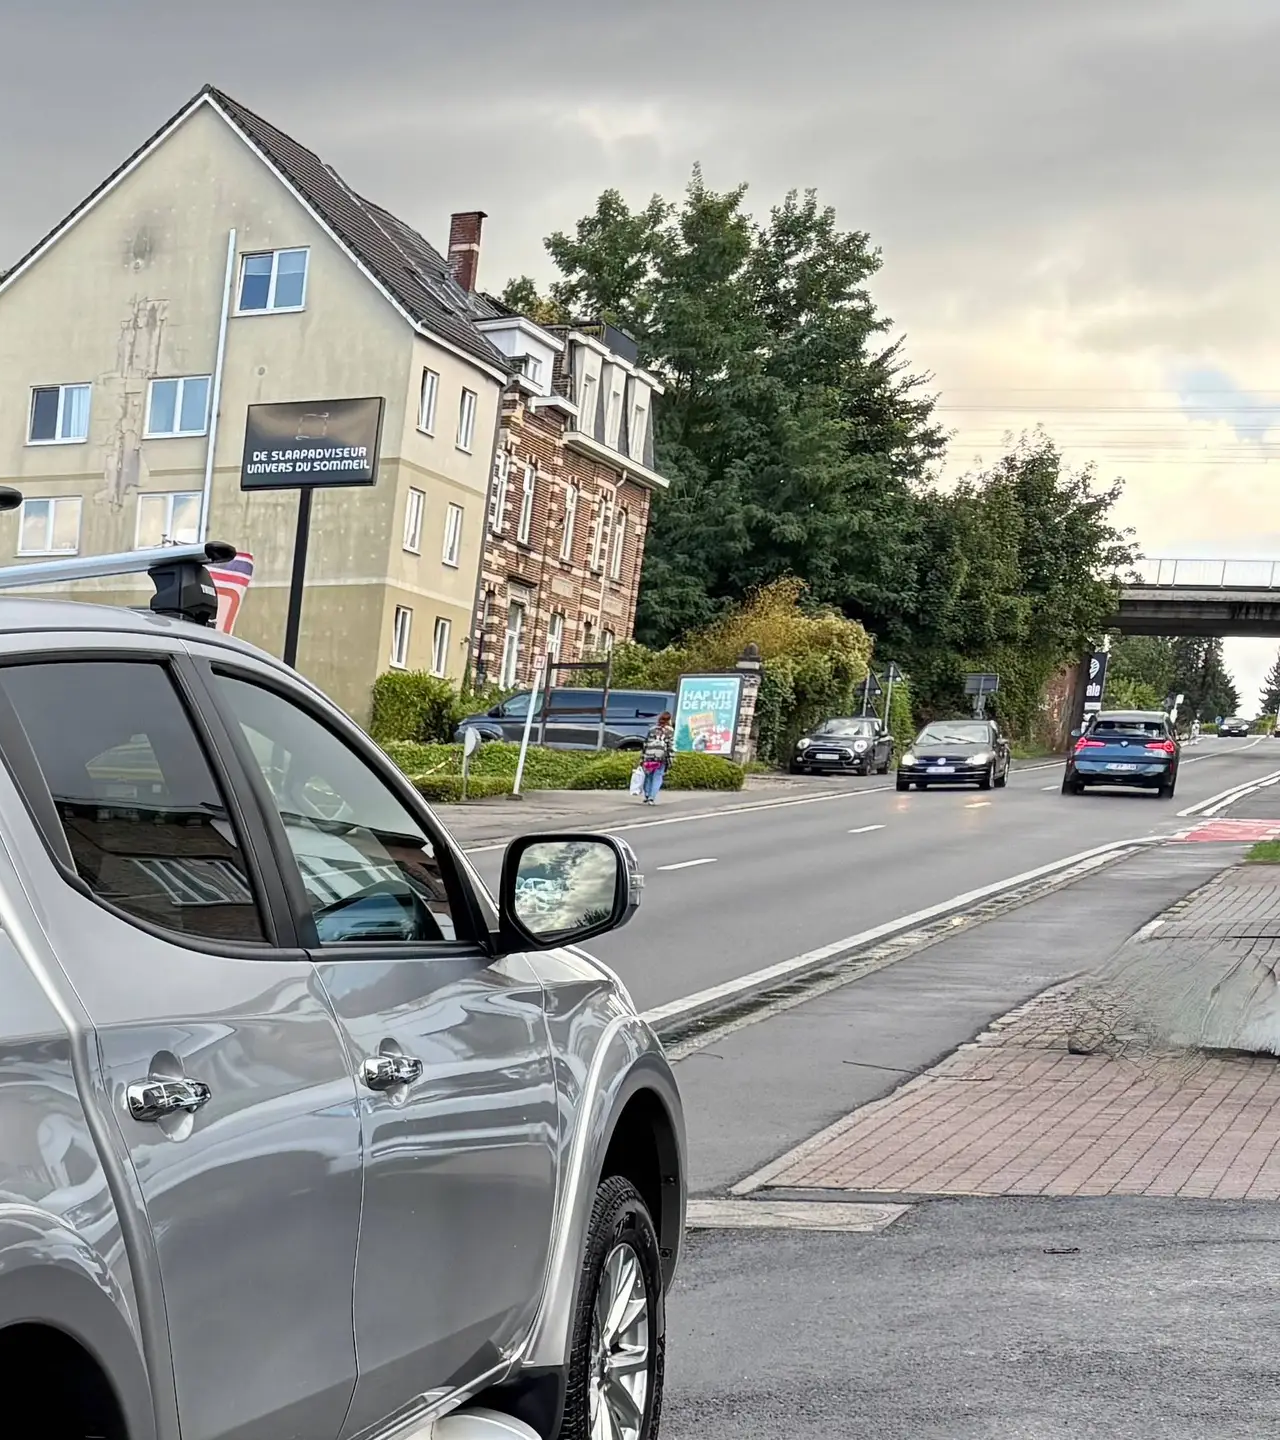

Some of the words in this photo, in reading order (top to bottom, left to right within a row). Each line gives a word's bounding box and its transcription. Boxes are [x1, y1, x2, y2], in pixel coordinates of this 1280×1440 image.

[253, 451, 268, 461] DE
[271, 447, 367, 460] SLAAPADVISEUR
[247, 462, 293, 474] UNIVERS
[296, 462, 310, 472] DU
[313, 459, 370, 471] SOMMEIL
[683, 690, 711, 700] HAP
[712, 689, 733, 700] UIT
[700, 700, 732, 710] PRIJS
